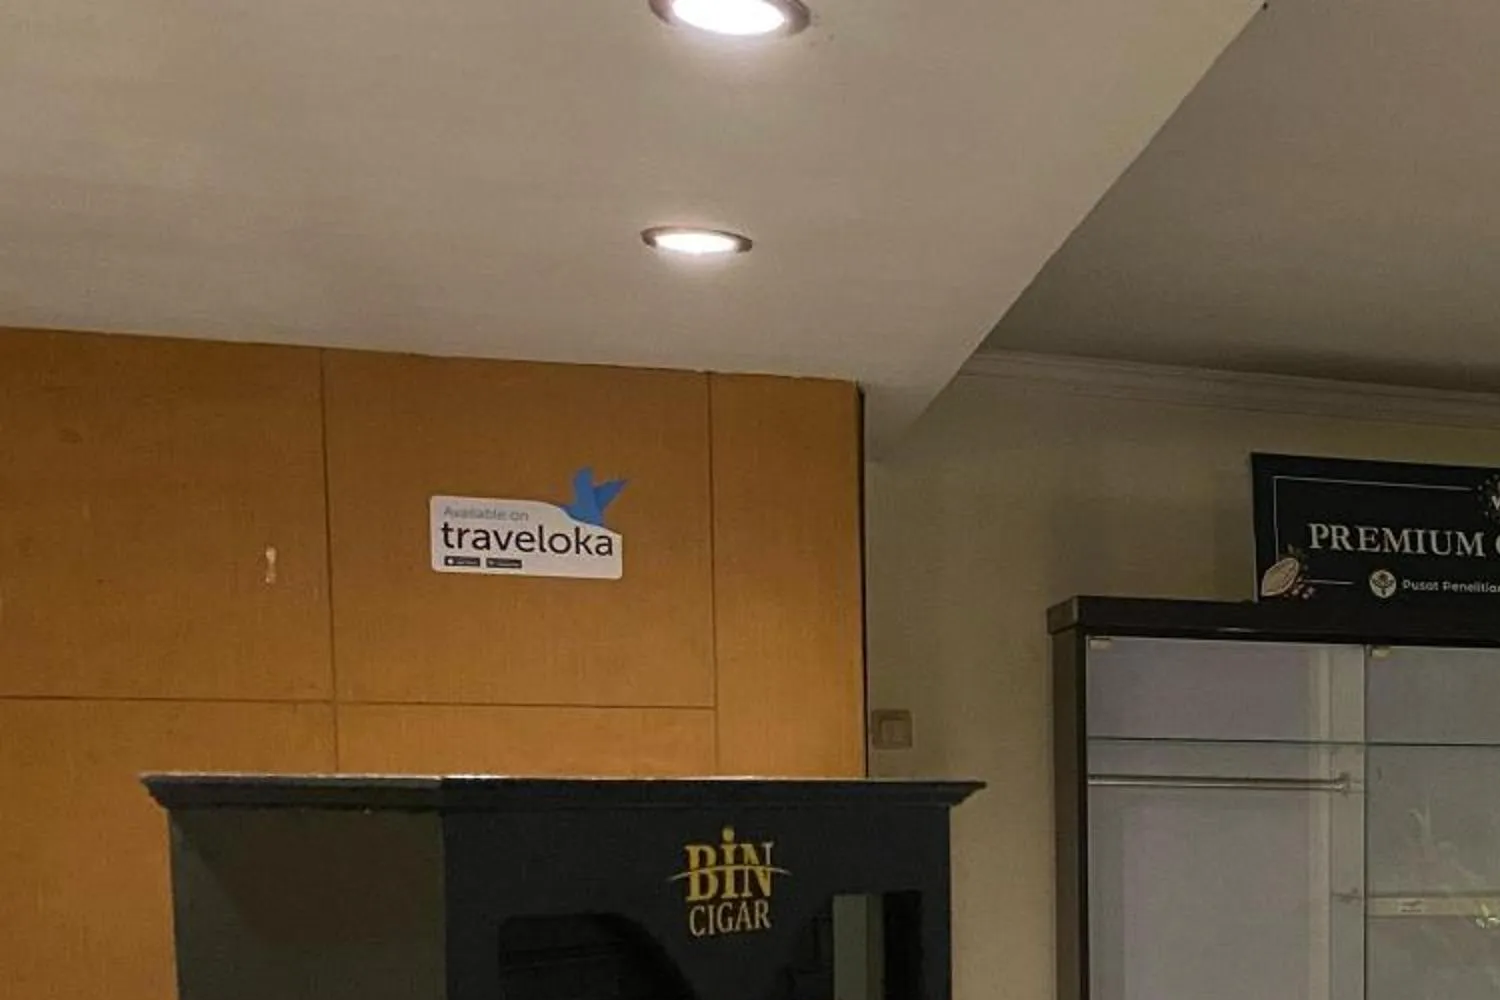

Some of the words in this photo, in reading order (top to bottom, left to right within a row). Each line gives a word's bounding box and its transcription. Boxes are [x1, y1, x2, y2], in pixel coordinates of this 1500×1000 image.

[443, 505, 507, 521] Available
[509, 510, 529, 522] on
[441, 522, 613, 556] traveloka
[1308, 522, 1487, 557] PREMIUM
[1402, 579, 1440, 592] Pusat
[688, 899, 772, 938] CIGAR
